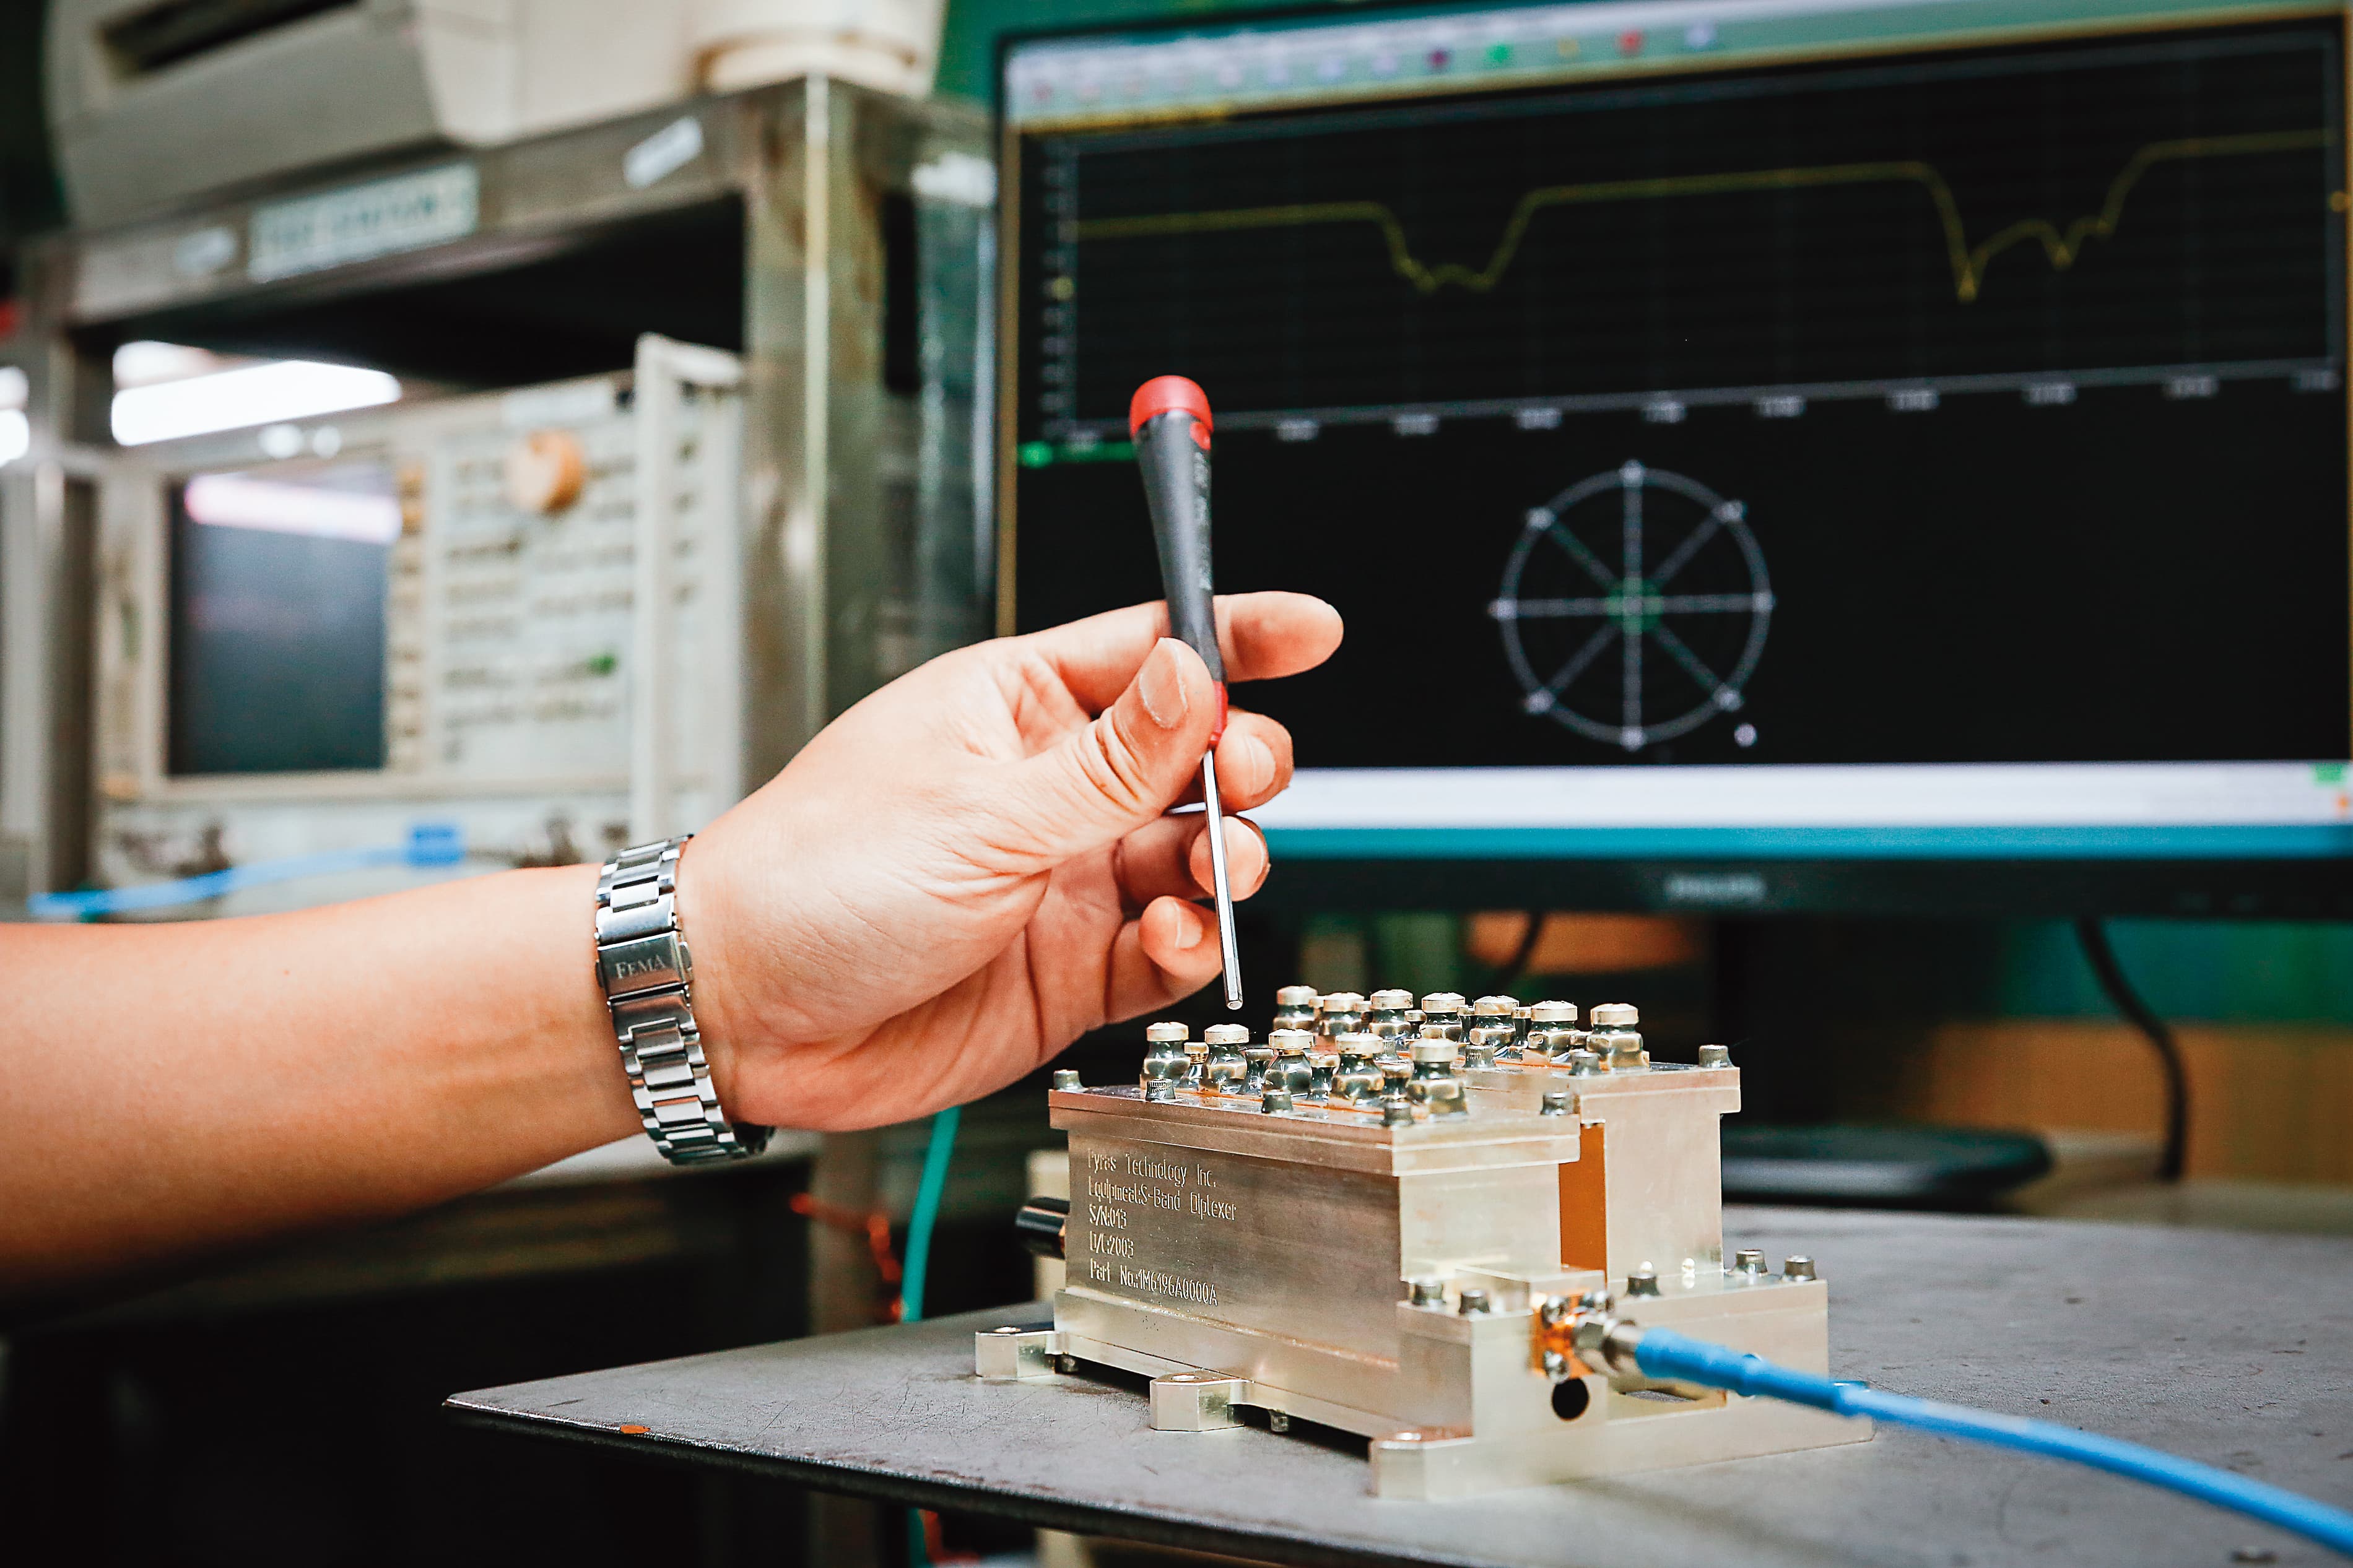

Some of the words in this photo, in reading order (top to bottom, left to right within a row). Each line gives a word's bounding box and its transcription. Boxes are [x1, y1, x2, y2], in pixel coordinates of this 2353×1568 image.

[615, 955, 666, 979] FEMA
[1125, 1153, 1187, 1188] Technology
[1197, 1163, 1216, 1188] Inc.
[1089, 1203, 1127, 1229] S/N:013
[1190, 1192, 1237, 1221] Diplexer
[1090, 1257, 1110, 1283] Part
